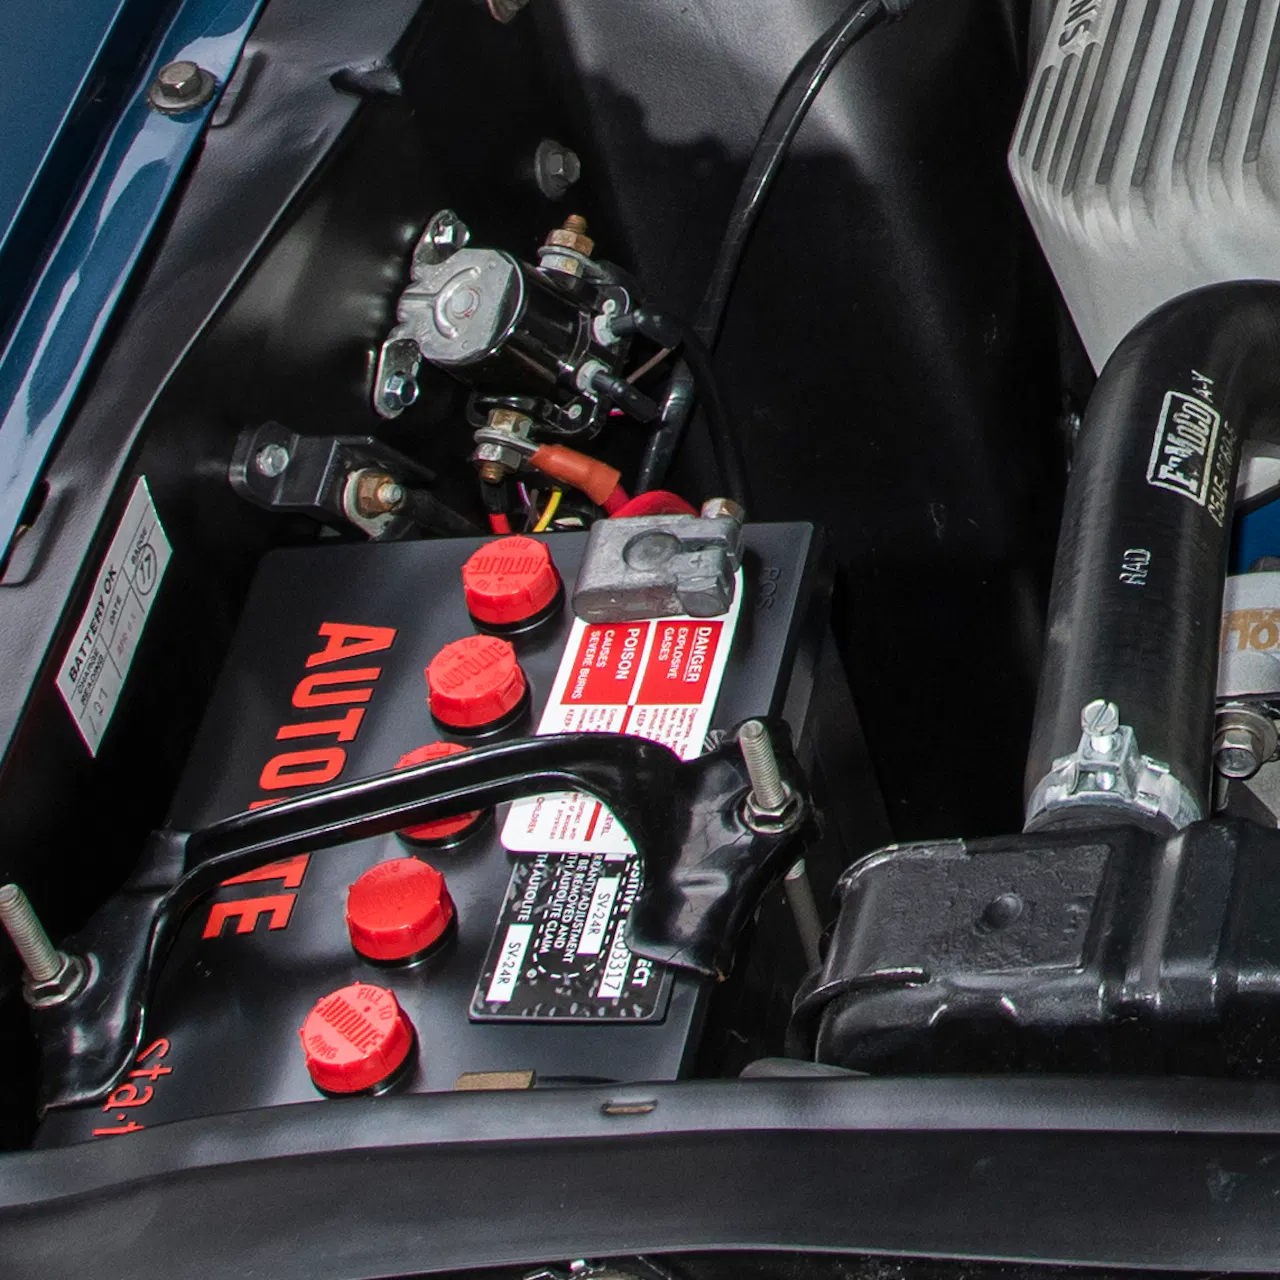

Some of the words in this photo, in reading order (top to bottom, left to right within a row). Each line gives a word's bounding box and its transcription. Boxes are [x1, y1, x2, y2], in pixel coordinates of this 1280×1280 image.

[1158, 400, 1211, 494] FoMoCo
[1119, 548, 1151, 586] RAD
[68, 602, 105, 683] BATTERY
[103, 564, 117, 595] OK
[108, 594, 123, 627] DATE
[582, 631, 601, 666] SEVERE
[596, 629, 615, 668] CAUSES
[615, 628, 641, 680] POISON
[658, 627, 675, 661] GASES
[666, 627, 689, 679] EXPLOSIVE
[685, 627, 712, 683] DANGER
[436, 641, 511, 693] AUTOLITE
[571, 667, 590, 700] BURNS
[202, 621, 398, 940] AUTOTE
[578, 859, 588, 872] BE
[518, 870, 541, 922] AUTOLITE
[550, 870, 573, 920] AUTOLITE
[561, 873, 585, 924] REMOVED
[588, 892, 611, 935] SV-24R
[540, 920, 558, 954] CLAIM
[554, 926, 569, 949] AND
[562, 894, 593, 964] ADJUSTMENT
[497, 941, 521, 984] SV-24R
[316, 995, 385, 1054] AUTOLITE
[357, 987, 381, 1006] FILL
[378, 1003, 393, 1021] TO
[308, 1034, 339, 1060] RING
